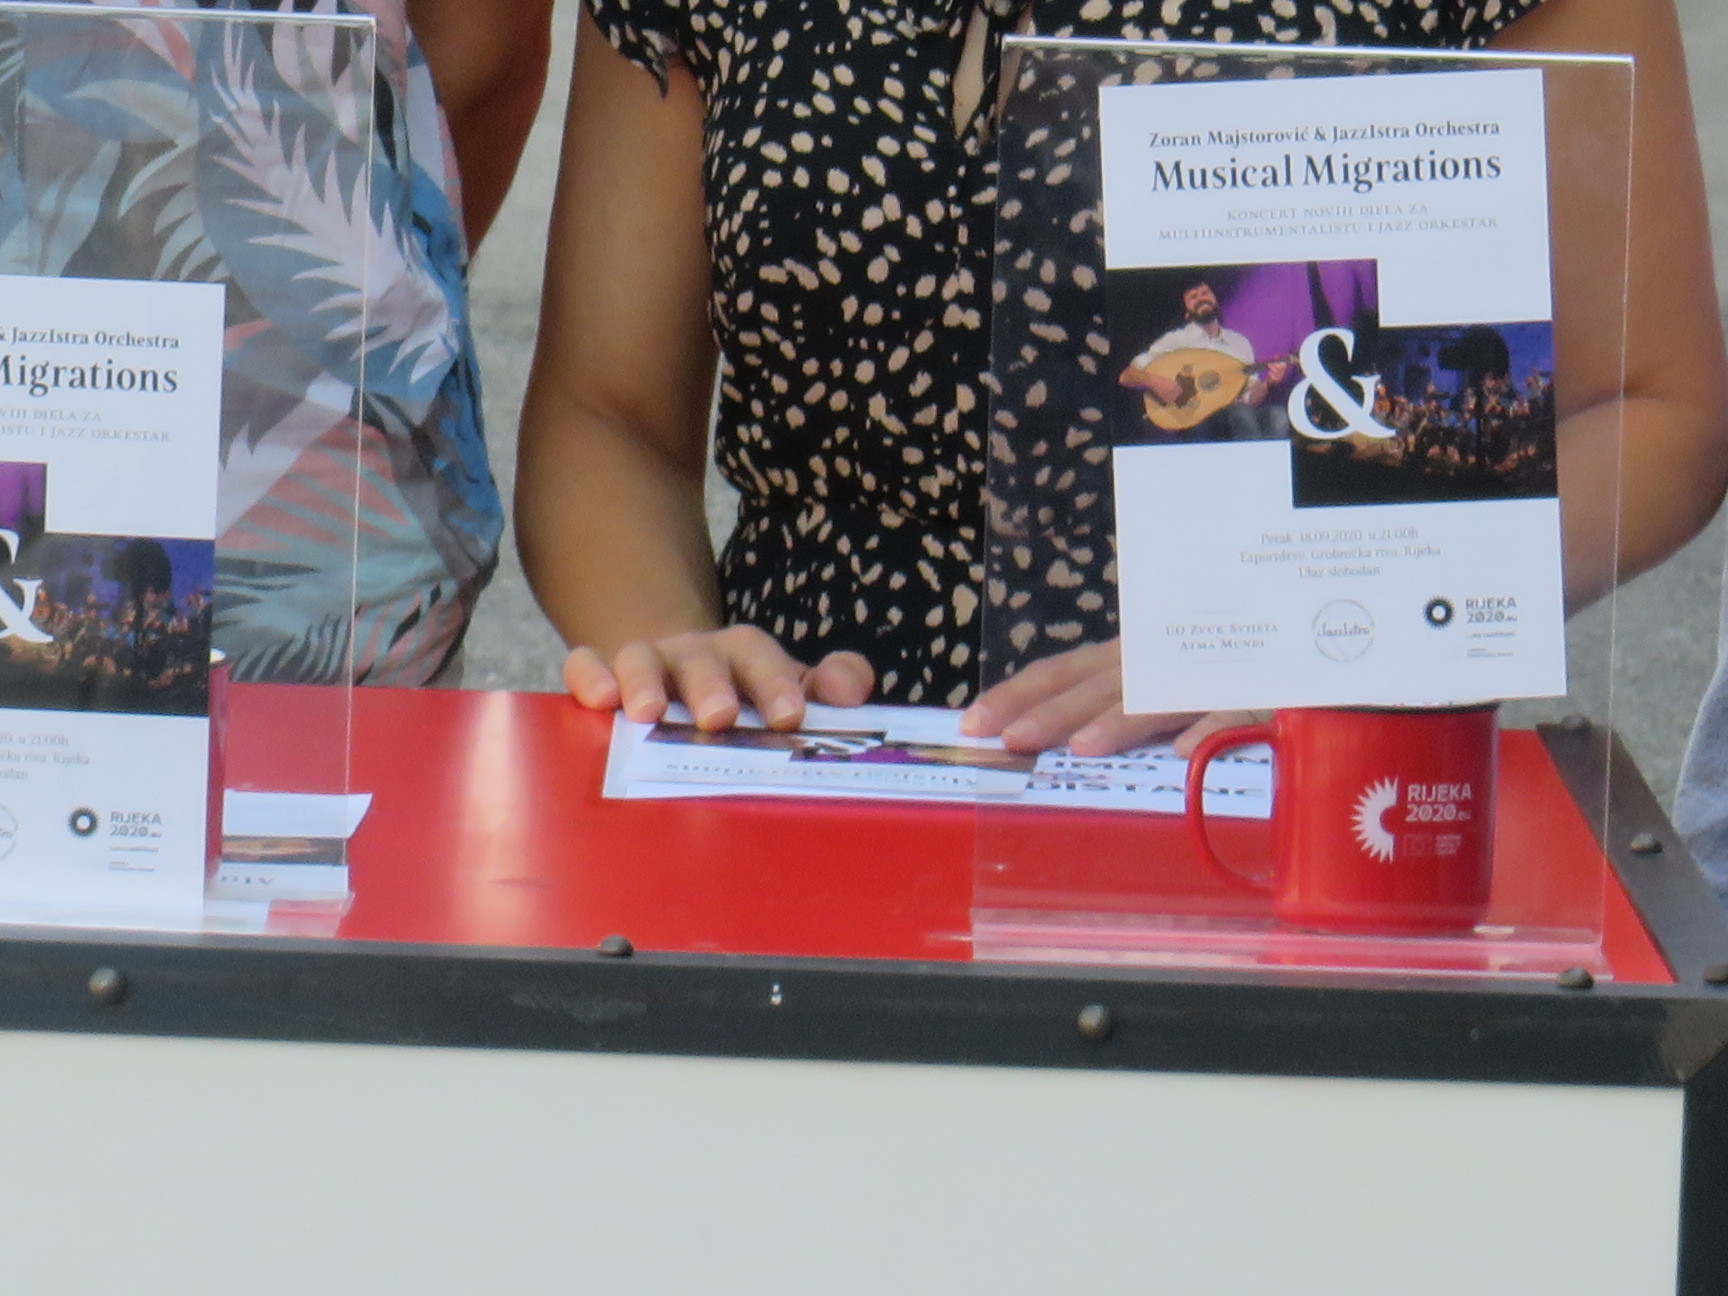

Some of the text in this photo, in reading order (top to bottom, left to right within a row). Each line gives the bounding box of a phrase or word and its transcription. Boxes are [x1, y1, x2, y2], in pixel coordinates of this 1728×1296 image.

[1149, 130, 1203, 149] Zoran
[1207, 125, 1310, 149] Majstorović
[1313, 124, 1327, 142] &
[1415, 118, 1501, 139] Orchestra
[1150, 148, 1503, 194] Musical Migrations
[1226, 207, 1298, 221] KONCERT
[1408, 201, 1429, 214] ZA
[1378, 219, 1414, 235] JAZZ
[1419, 215, 1499, 231] ORKESTAR
[93, 330, 180, 350] Orchestra
[1286, 326, 1398, 441] &
[81, 410, 102, 422] ZA
[49, 426, 87, 440] JAZZ
[1464, 596, 1518, 611] RIJEKA
[1406, 782, 1473, 802] RIJEKA
[109, 809, 163, 826] RIJEKA
